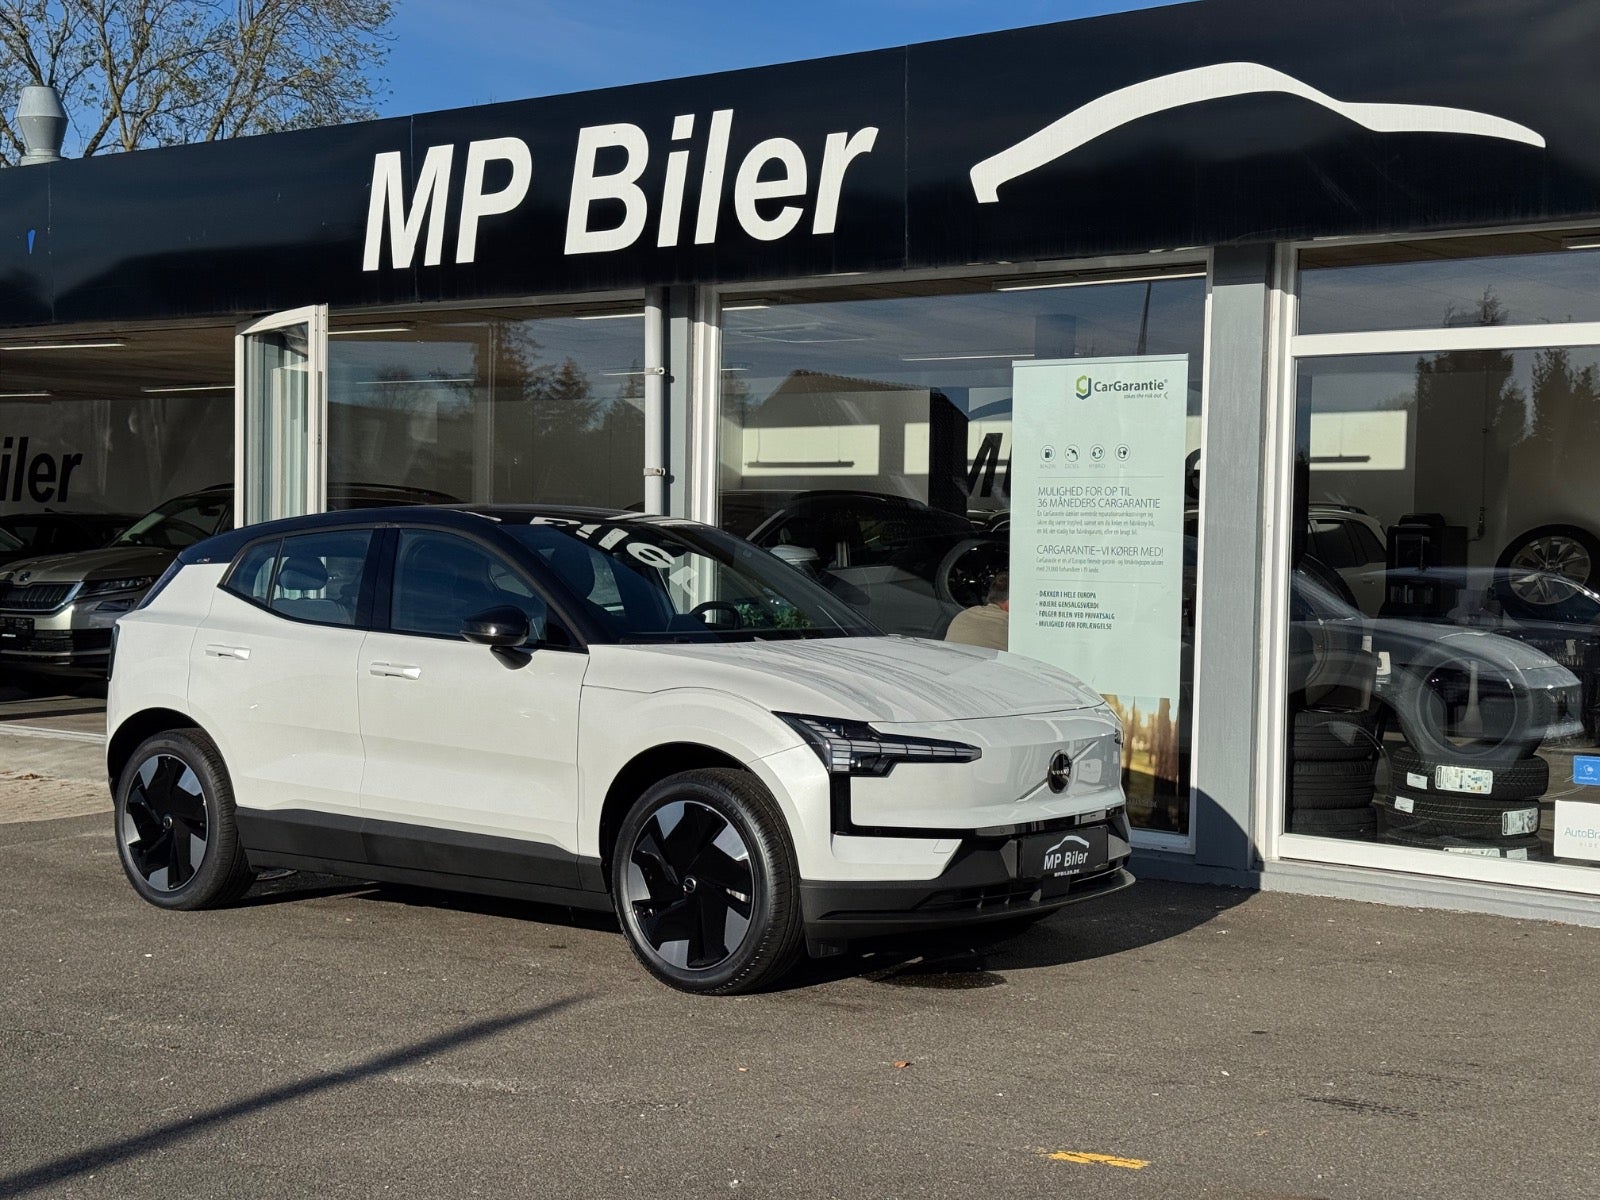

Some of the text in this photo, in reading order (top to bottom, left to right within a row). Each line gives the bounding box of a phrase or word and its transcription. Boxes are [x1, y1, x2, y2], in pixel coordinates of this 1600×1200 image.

[363, 109, 879, 271] MP Biler
[1037, 486, 1132, 496] MULIGHED FOR OP TIL
[1037, 497, 1161, 508] 36 MÅNEDERS CARGARANTIE
[1111, 545, 1139, 557] KØRER
[1140, 546, 1164, 557] MED!
[1077, 591, 1097, 599] EUROPA
[1084, 612, 1115, 620] PRIVATSALG
[1043, 850, 1089, 870] MP Biler
